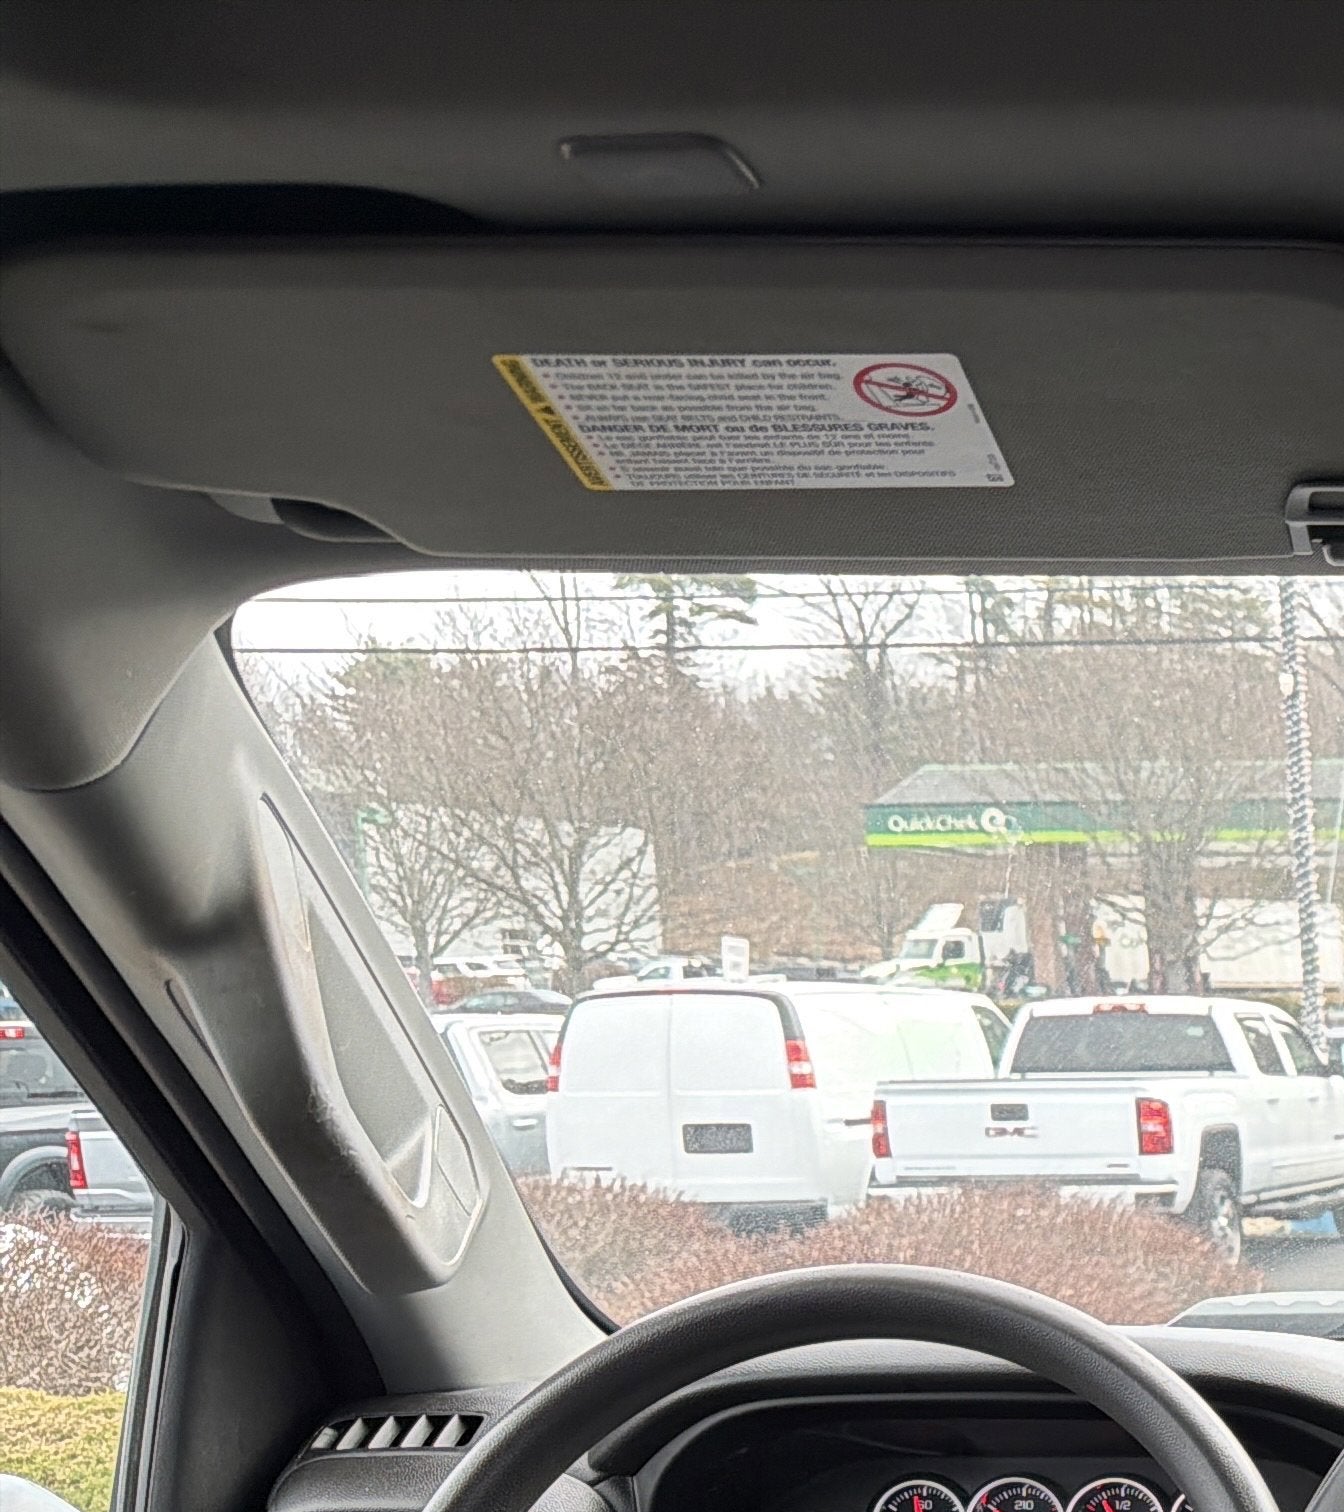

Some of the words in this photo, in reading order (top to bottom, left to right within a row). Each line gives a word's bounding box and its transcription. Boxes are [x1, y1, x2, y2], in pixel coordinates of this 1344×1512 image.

[531, 359, 587, 367] DEATH
[612, 359, 685, 367] SERIOUS
[687, 358, 746, 367] INJURY
[578, 424, 645, 433] DANGER
[674, 424, 720, 433] MORT
[771, 423, 865, 432] BLESSURES
[1013, 1501, 1034, 1510] 210
[1114, 1500, 1132, 1511] 1/2
